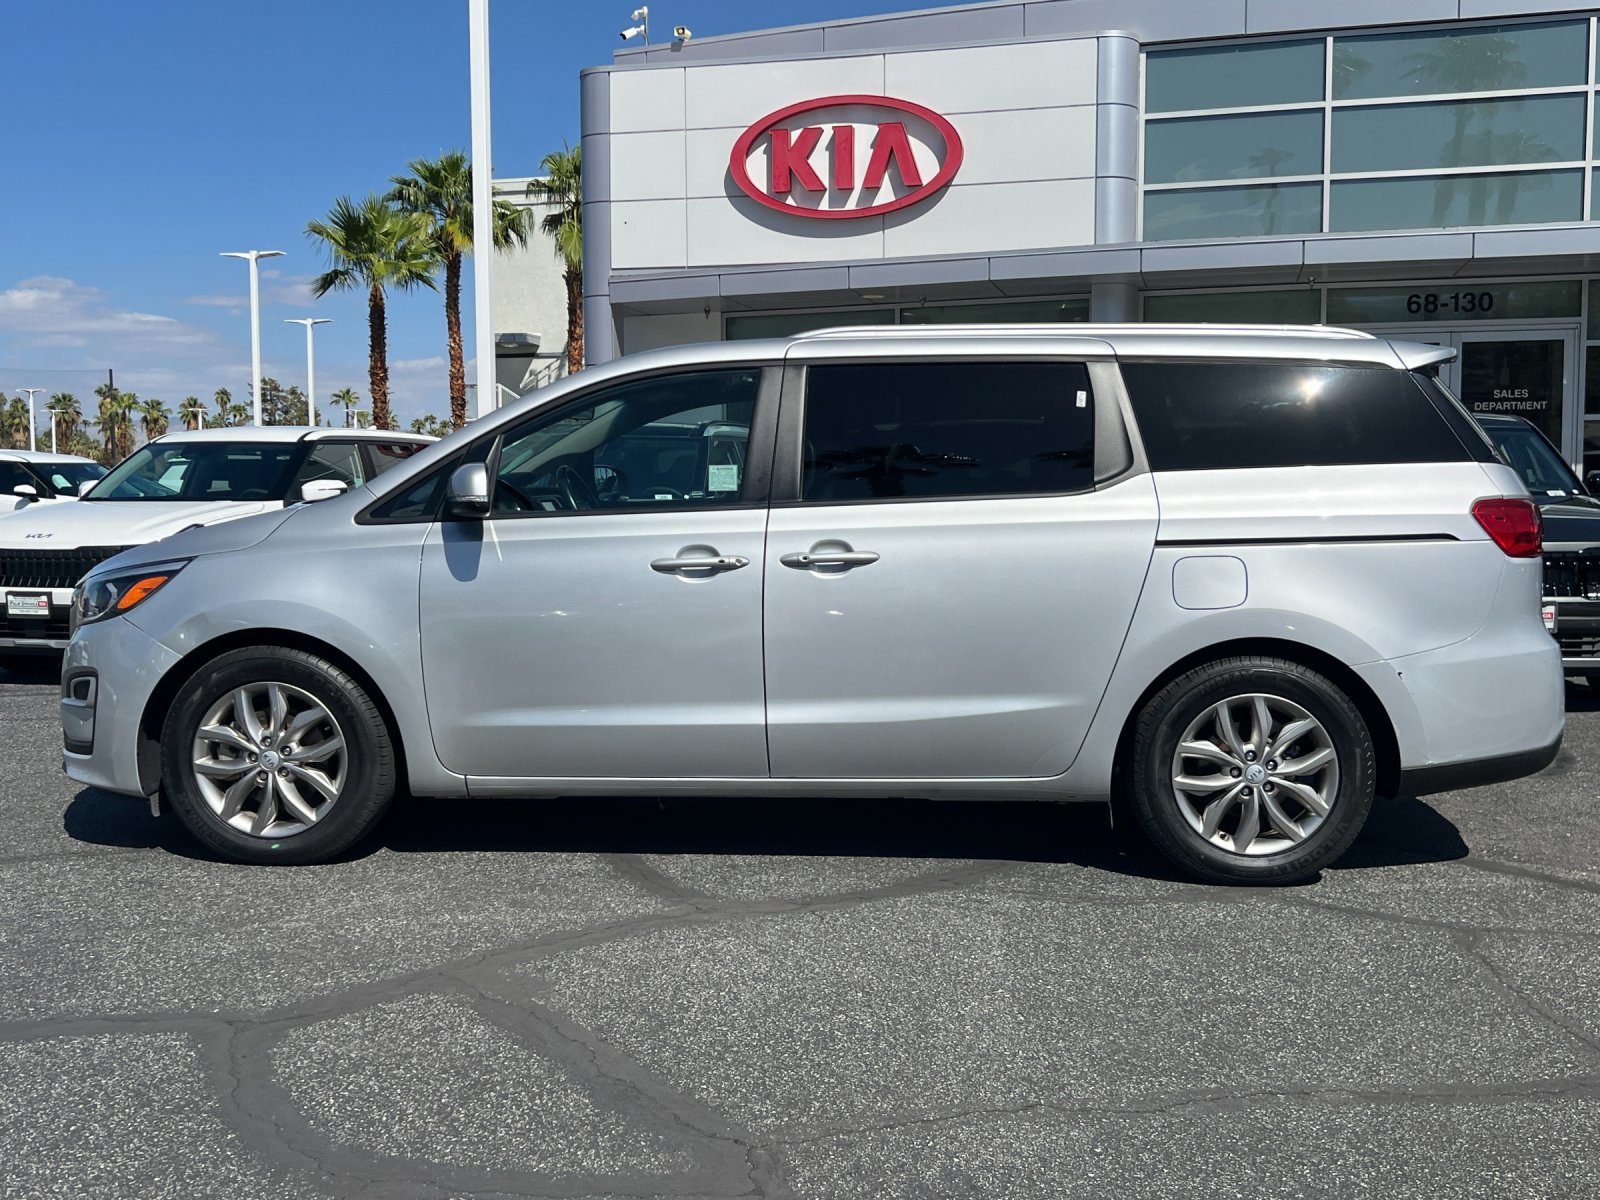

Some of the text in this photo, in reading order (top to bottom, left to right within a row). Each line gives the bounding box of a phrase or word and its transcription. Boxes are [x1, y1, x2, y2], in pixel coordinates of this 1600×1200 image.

[769, 121, 923, 193] KIA
[1407, 291, 1494, 314] 68-130
[1493, 389, 1529, 398] SALES
[1474, 401, 1548, 411] DEPARTMENT
